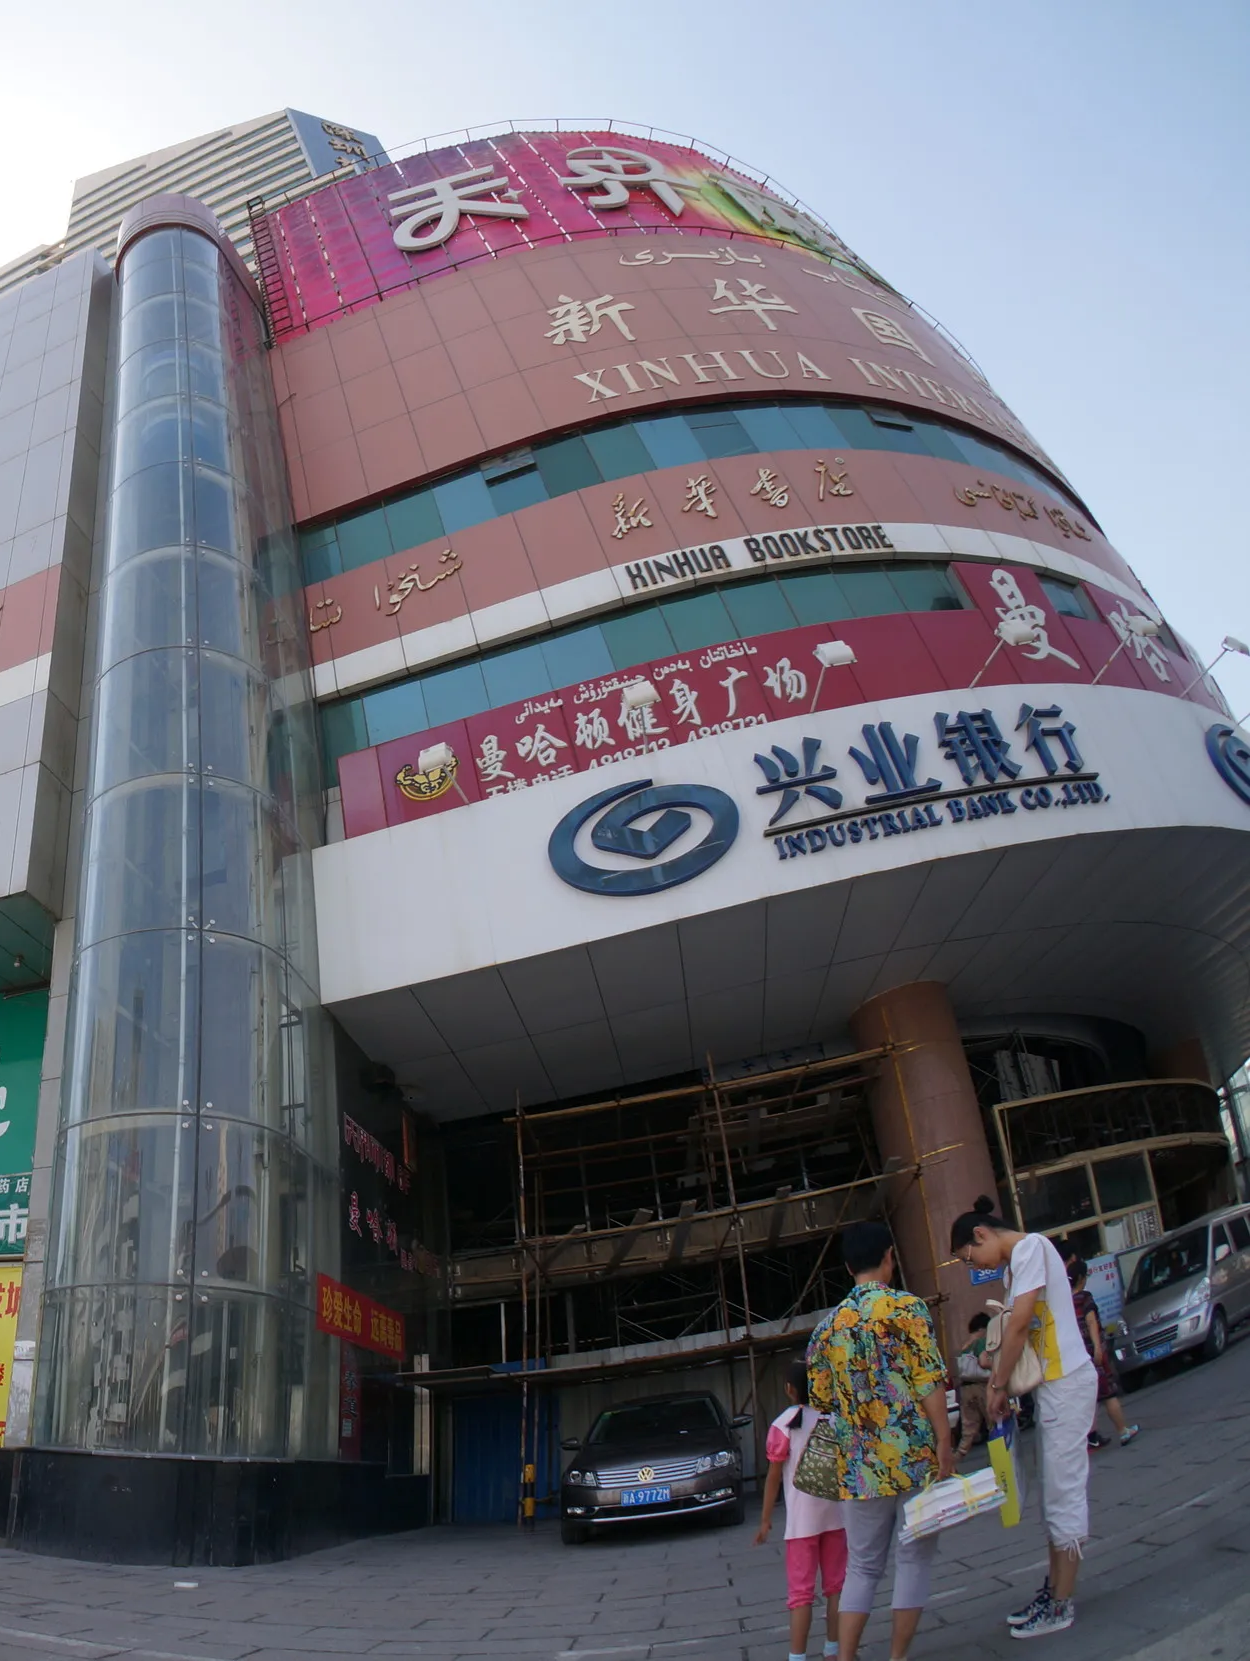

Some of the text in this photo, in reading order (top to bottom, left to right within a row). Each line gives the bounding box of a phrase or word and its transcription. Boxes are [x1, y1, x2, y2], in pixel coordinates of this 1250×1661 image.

[574, 350, 832, 404] XINHUA
[743, 525, 894, 563] BOOKSTORE
[754, 702, 1086, 827] 兴业银行
[773, 804, 944, 861] INDUSTRIAL
[946, 790, 1018, 824] BANK
